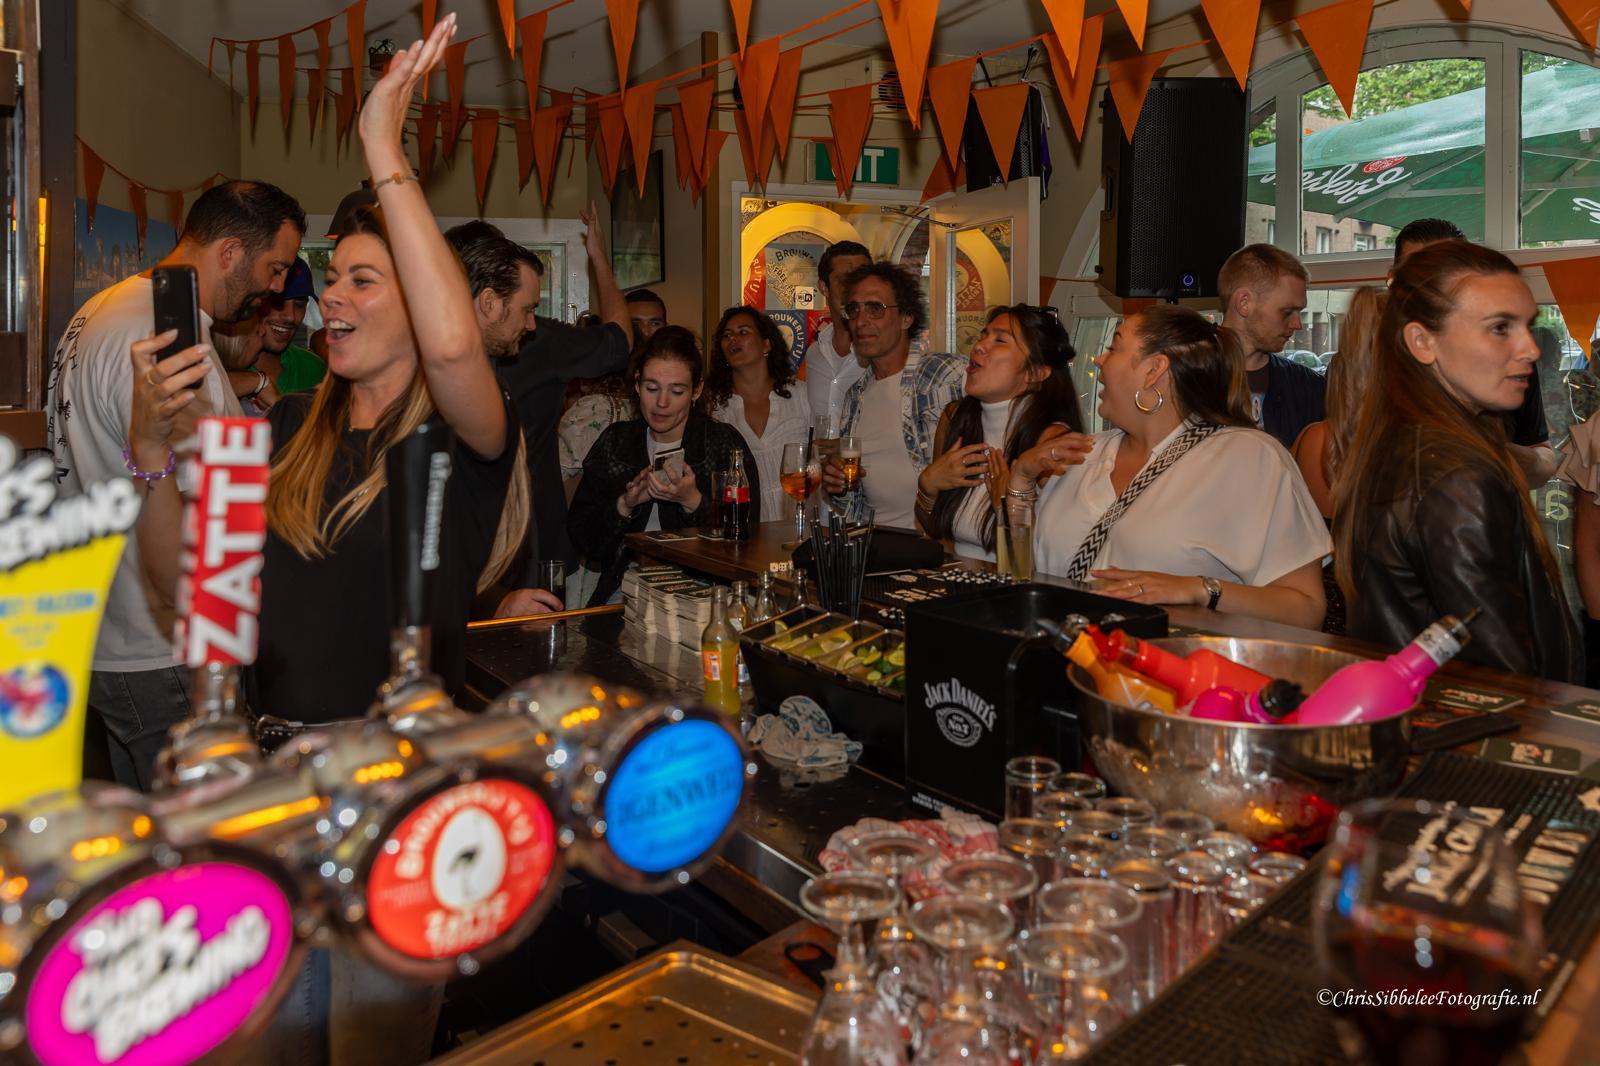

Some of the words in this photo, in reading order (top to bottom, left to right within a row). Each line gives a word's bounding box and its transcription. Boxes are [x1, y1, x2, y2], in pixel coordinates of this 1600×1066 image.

[768, 312, 805, 341] ROUWERIJ
[187, 418, 272, 668] ZATTE
[924, 682, 951, 708] JACK
